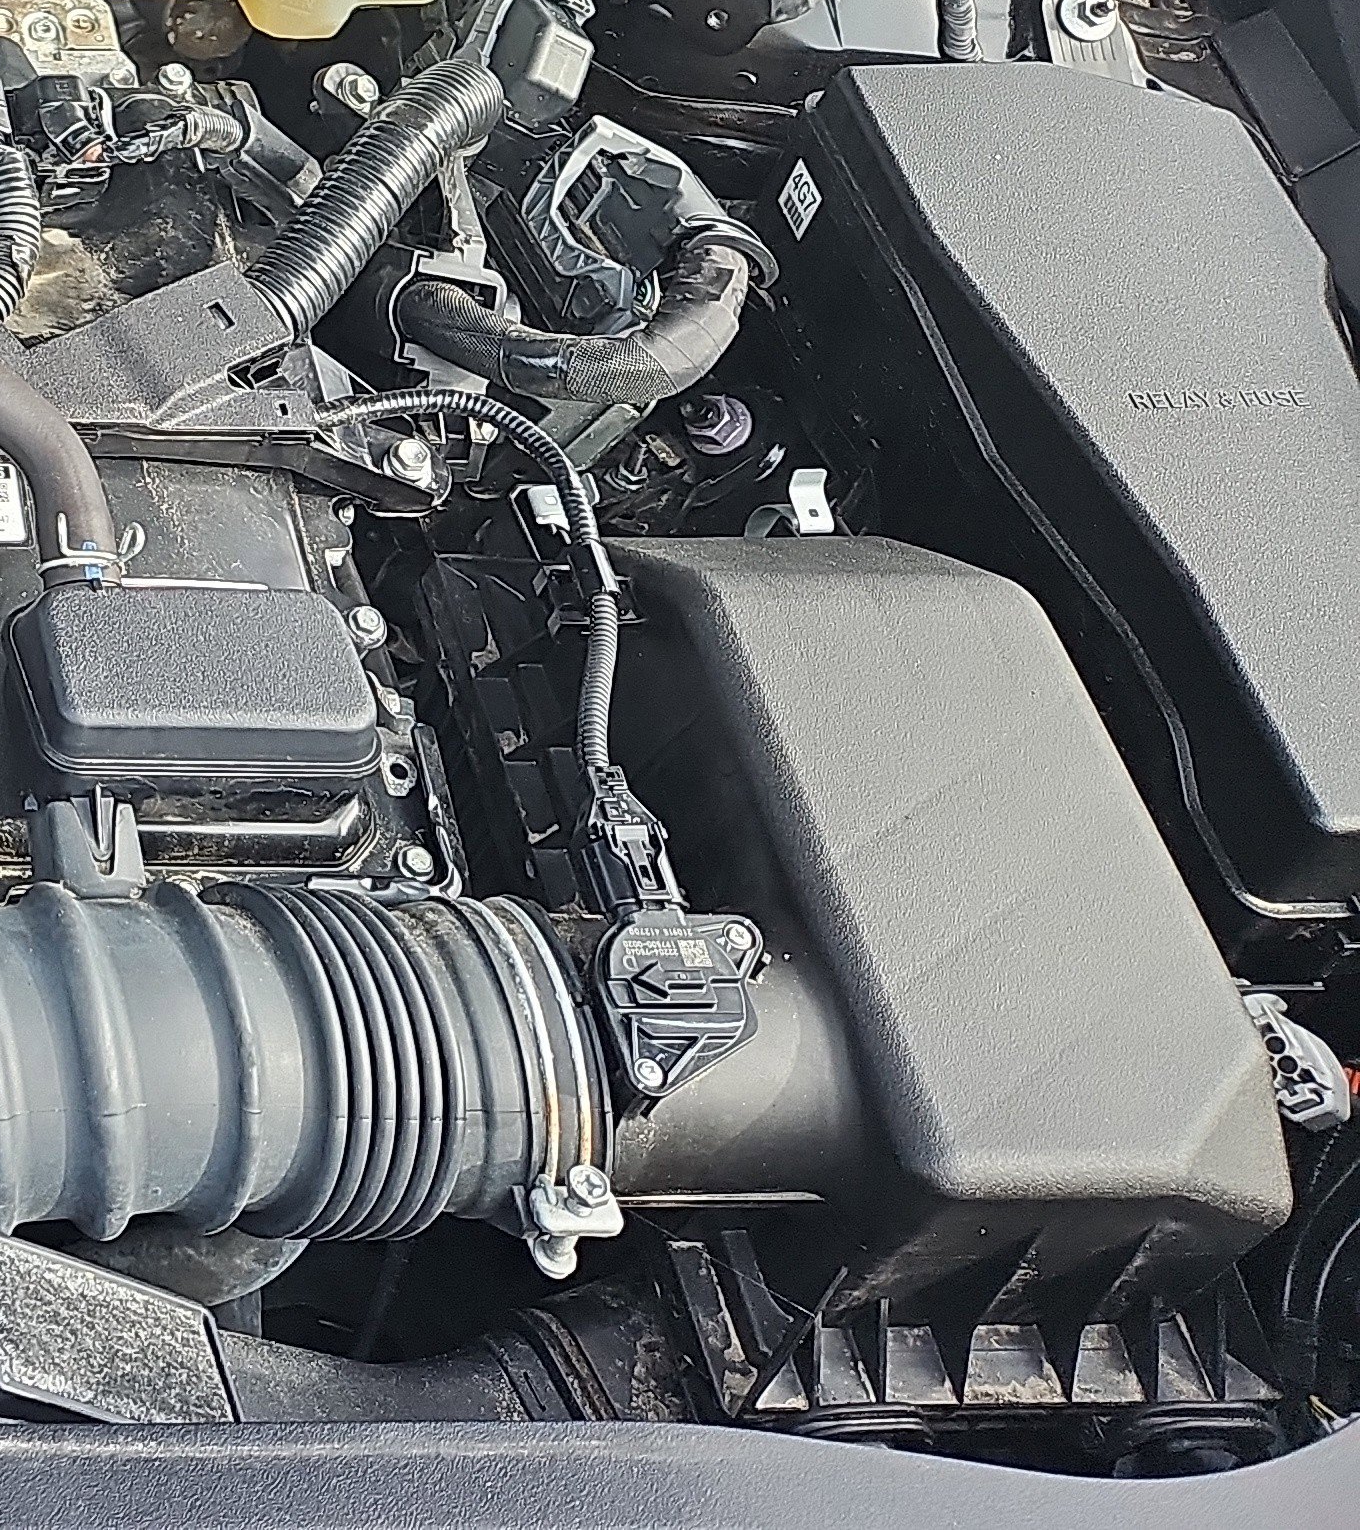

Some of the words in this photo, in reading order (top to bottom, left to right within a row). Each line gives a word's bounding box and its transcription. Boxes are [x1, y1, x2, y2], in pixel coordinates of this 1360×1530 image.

[792, 173, 817, 213] 4G7
[1128, 390, 1210, 410] RELAY
[1217, 391, 1236, 409] &
[1238, 390, 1312, 409] FUSE
